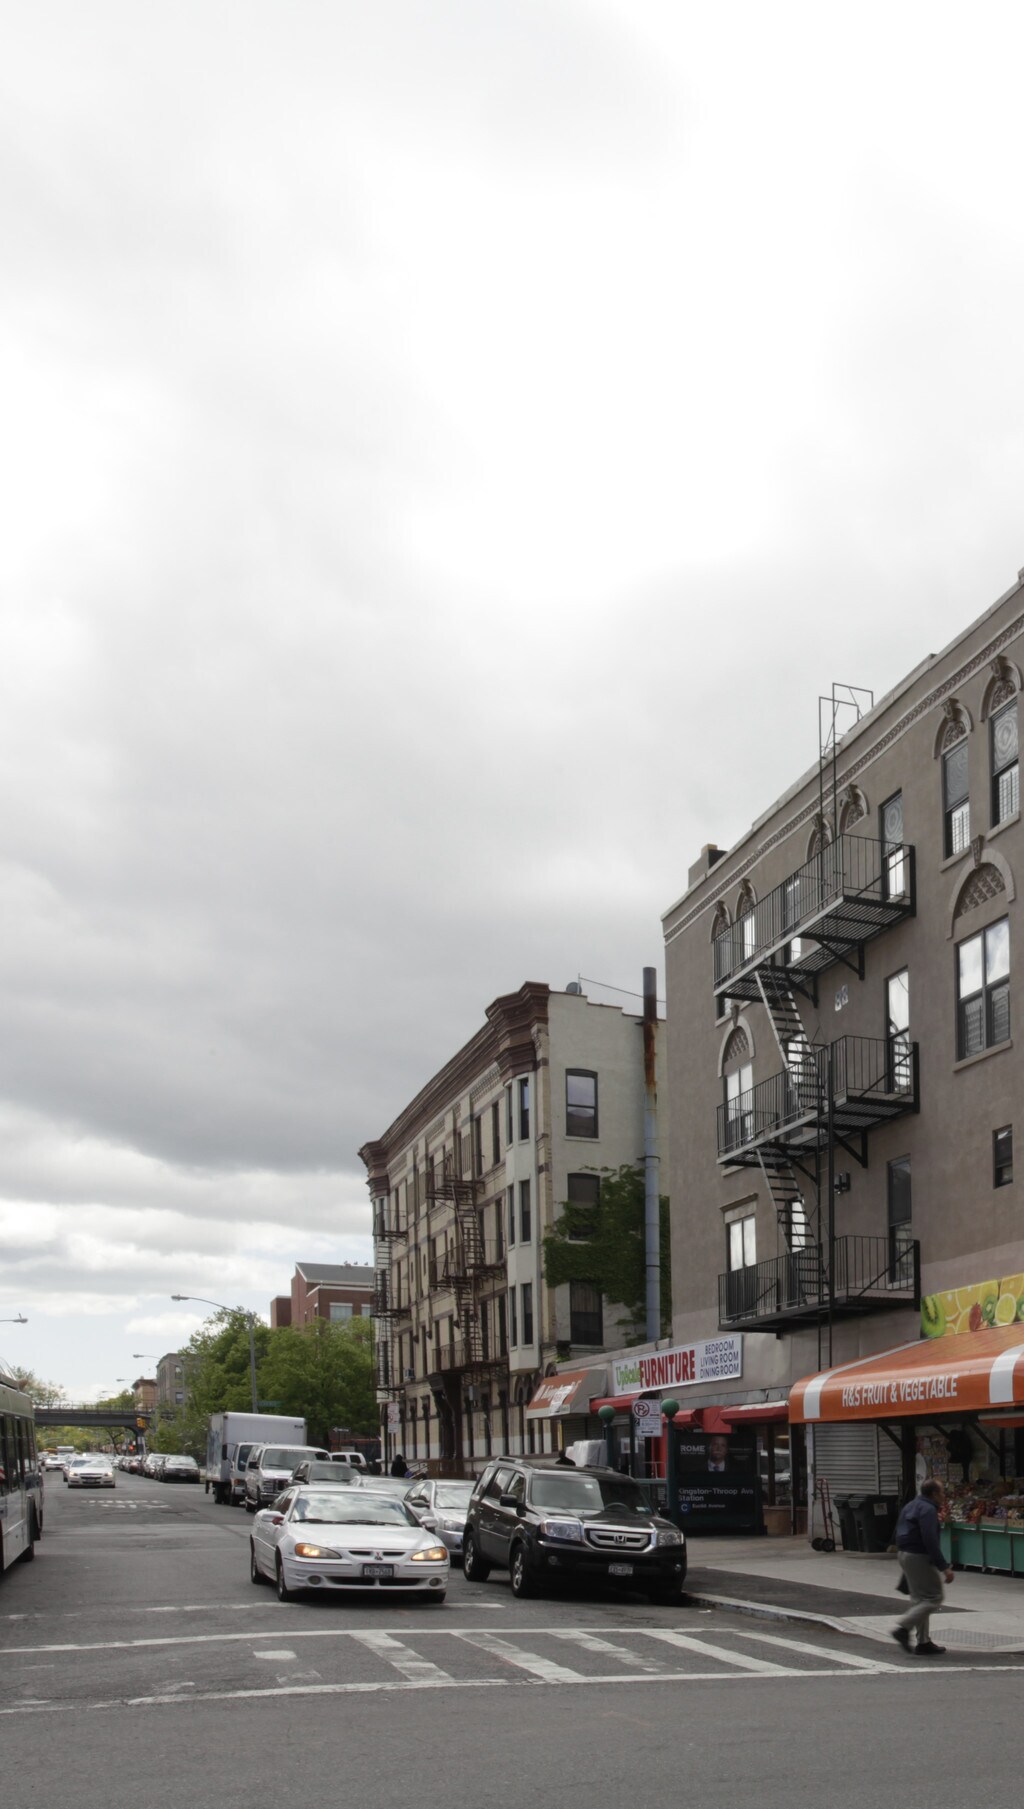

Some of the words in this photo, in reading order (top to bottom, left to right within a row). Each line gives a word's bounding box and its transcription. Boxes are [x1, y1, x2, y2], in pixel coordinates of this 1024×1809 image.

[704, 1340, 734, 1355] BEDROOM
[700, 1354, 719, 1367] LIVING
[719, 1351, 739, 1364] ROOM
[639, 1350, 695, 1388] FURNITURE
[700, 1366, 720, 1379] DINING
[720, 1363, 739, 1376] ROOM
[842, 1386, 860, 1407] H&S
[862, 1383, 889, 1405] FRUIT
[889, 1382, 897, 1403] &
[900, 1374, 959, 1402] VEGETABLE
[681, 1504, 688, 1512] C
